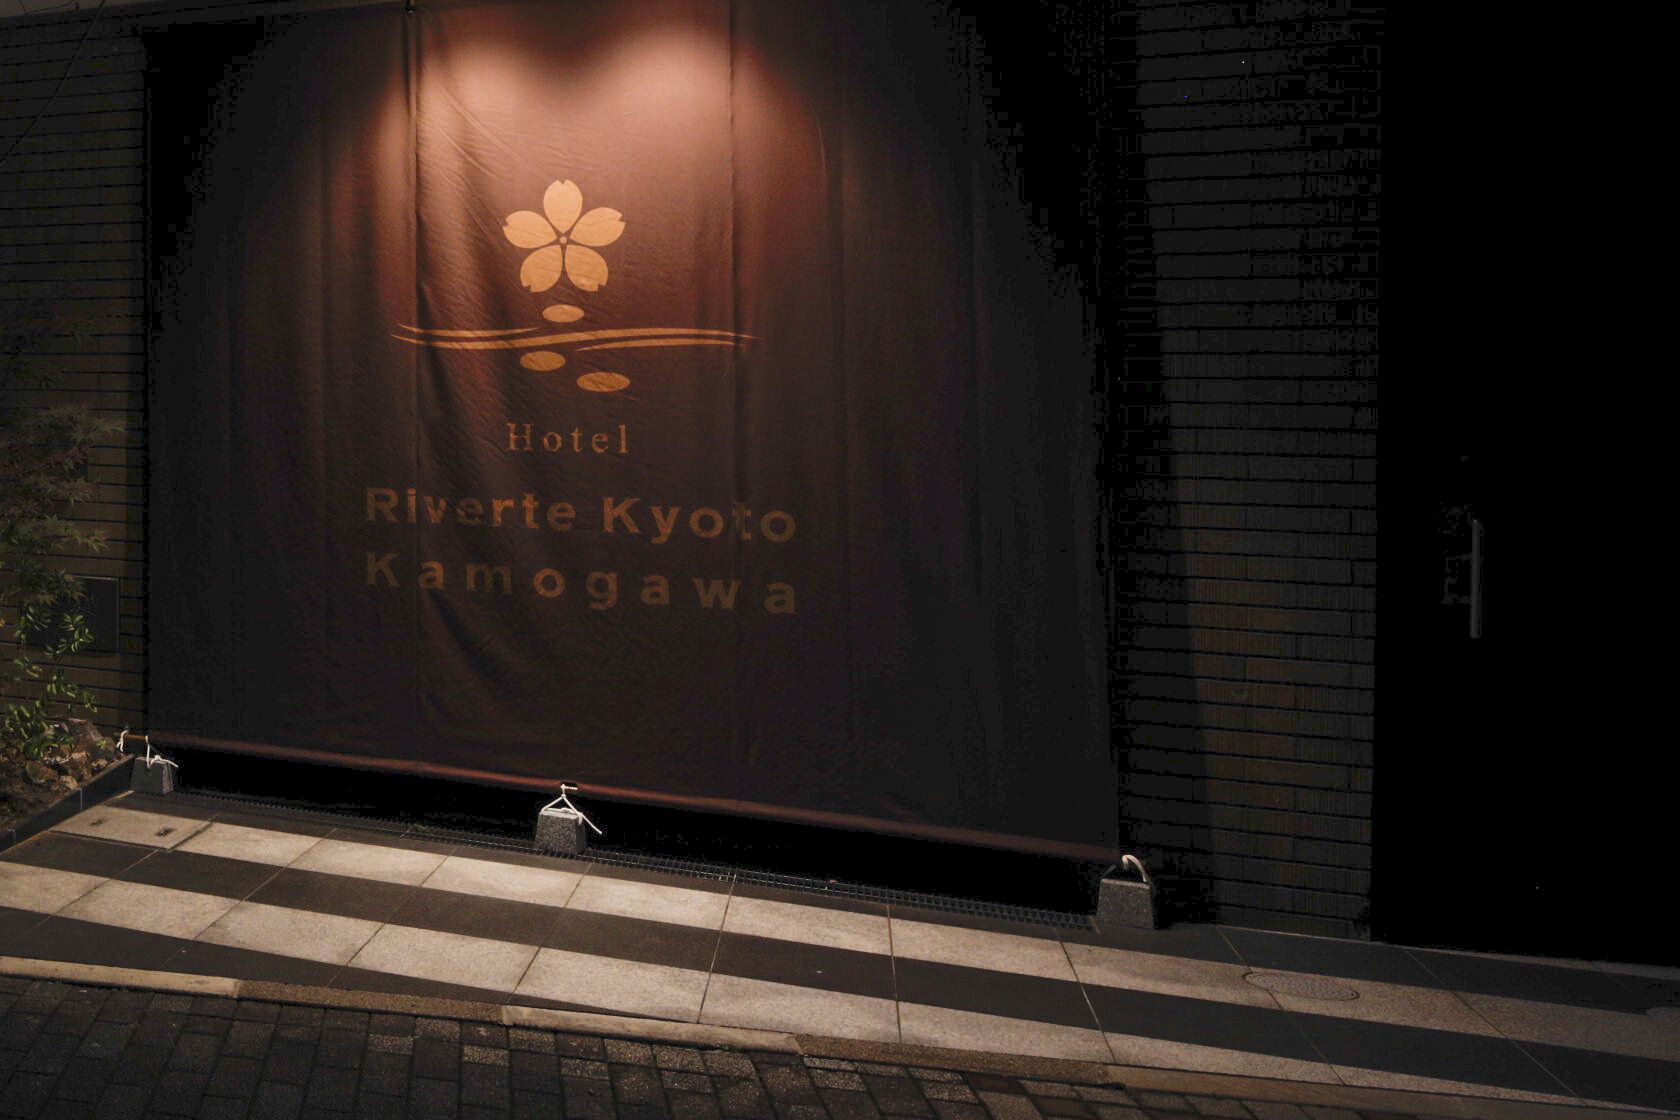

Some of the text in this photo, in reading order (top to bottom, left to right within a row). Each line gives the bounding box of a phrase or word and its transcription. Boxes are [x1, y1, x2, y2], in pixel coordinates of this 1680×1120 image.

[506, 422, 630, 455] Hotel
[365, 486, 797, 544] Riverte Kyoto
[365, 551, 798, 615] Kamogawa
